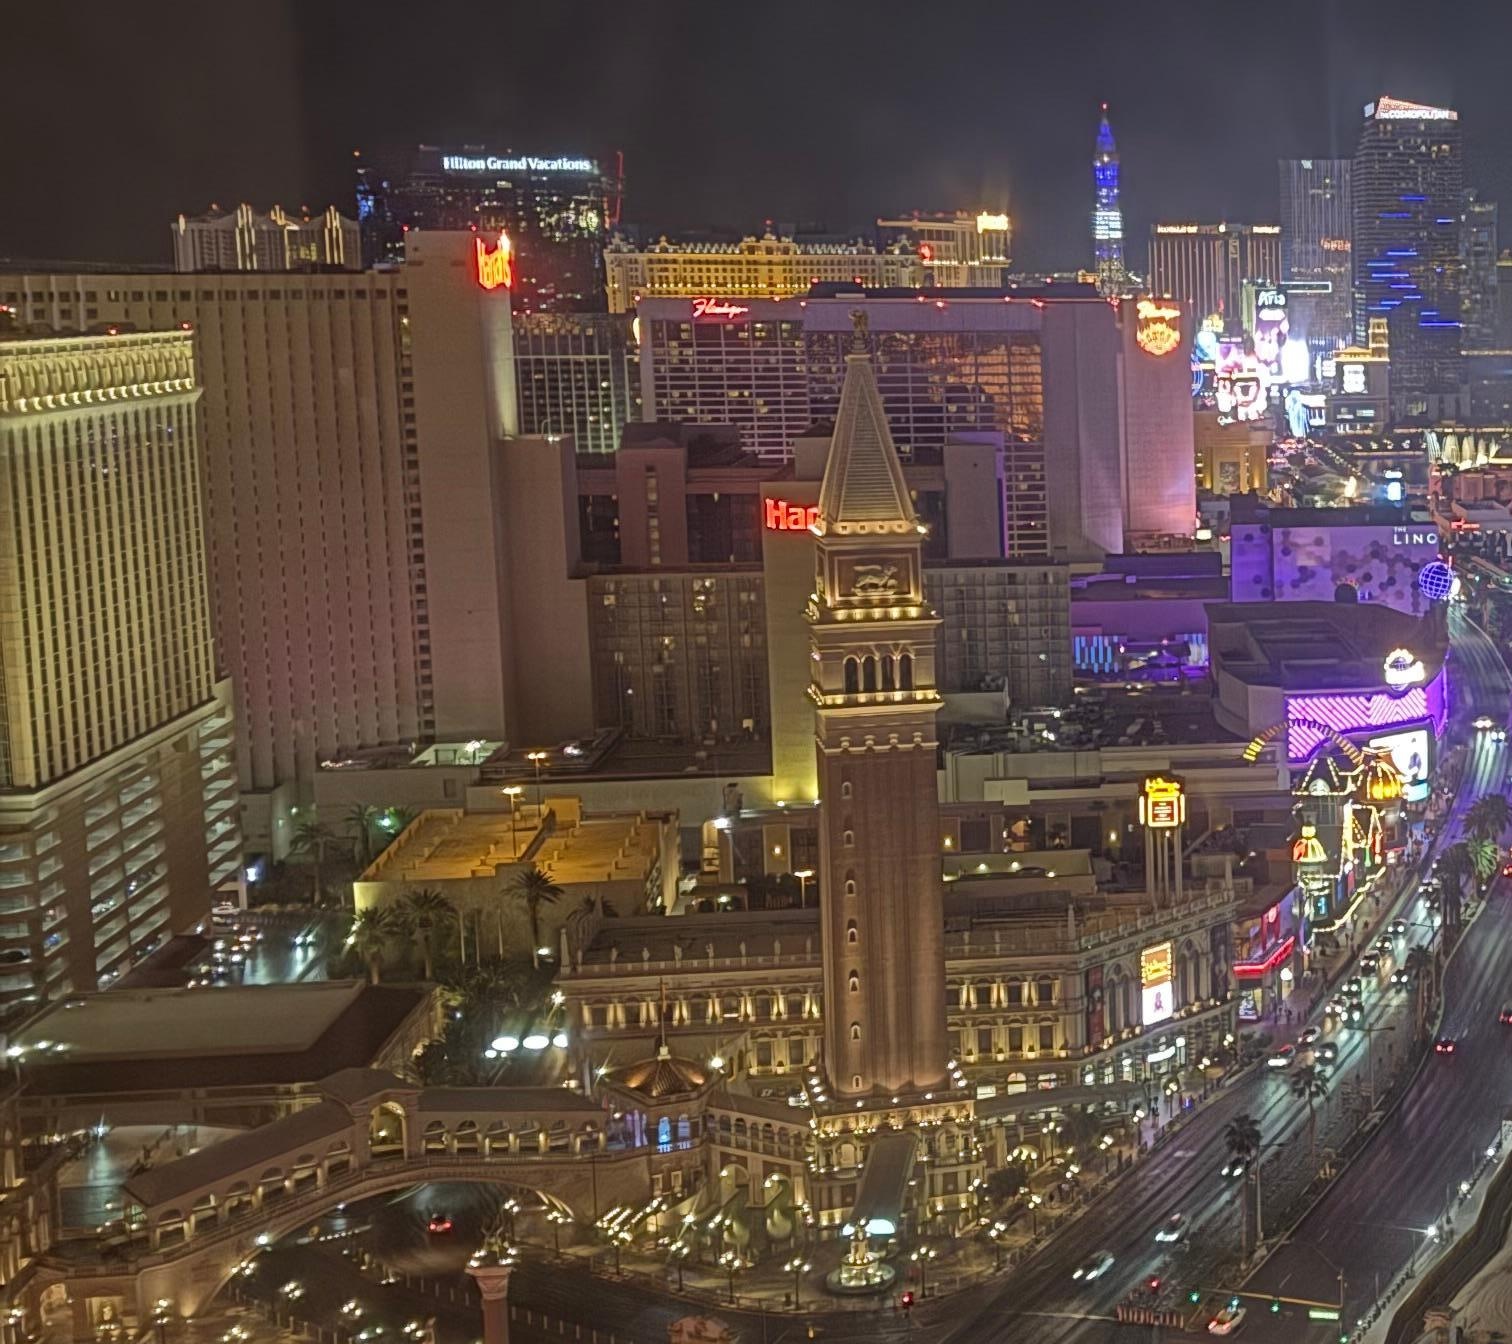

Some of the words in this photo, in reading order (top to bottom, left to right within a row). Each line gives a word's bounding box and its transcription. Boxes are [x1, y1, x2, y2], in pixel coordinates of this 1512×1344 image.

[443, 156, 485, 170] Hilton
[487, 156, 527, 170] Grand
[528, 157, 592, 170] Vacations
